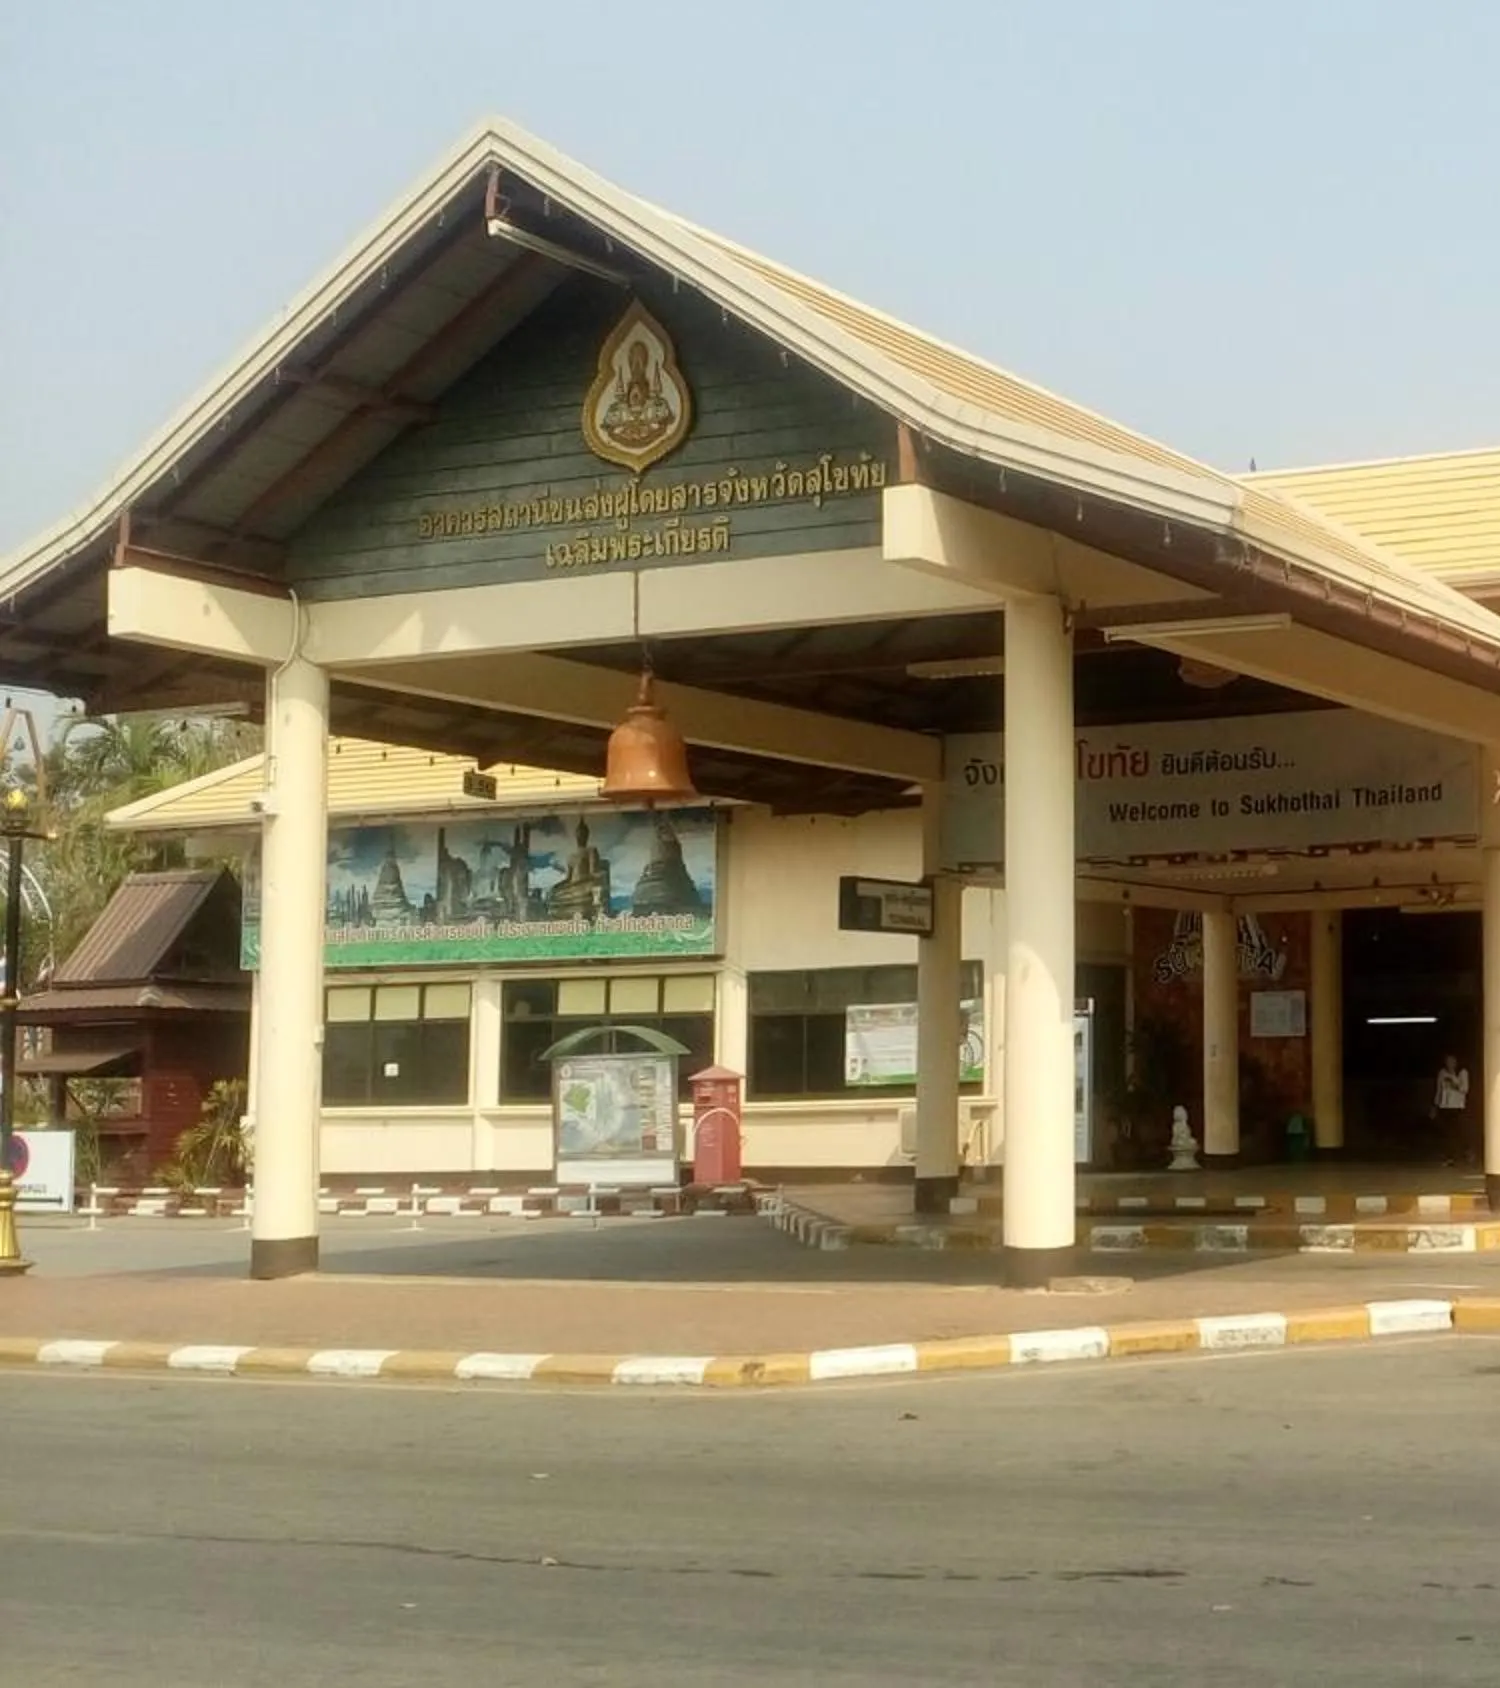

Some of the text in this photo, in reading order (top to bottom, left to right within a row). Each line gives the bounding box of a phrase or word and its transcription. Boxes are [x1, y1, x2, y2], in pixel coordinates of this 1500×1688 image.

[1108, 782, 1443, 822] Welcome to Sukhothai Thailand
